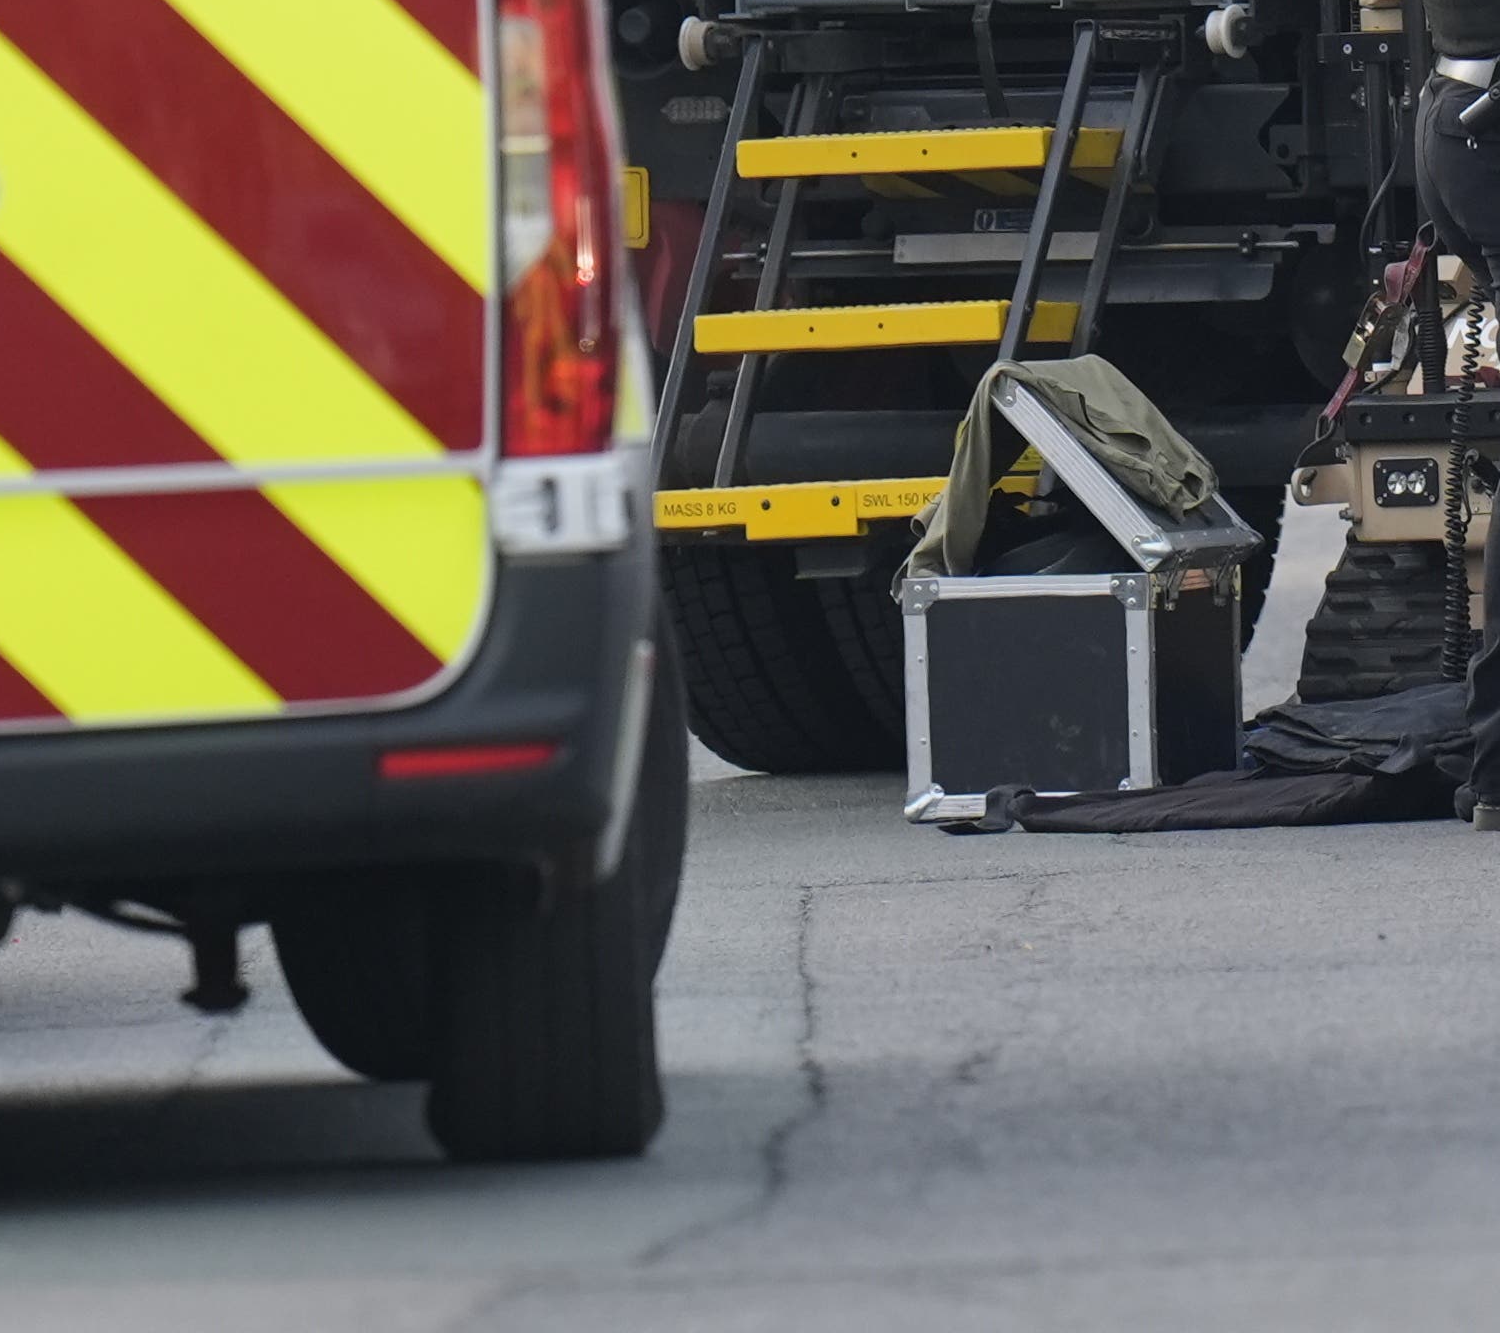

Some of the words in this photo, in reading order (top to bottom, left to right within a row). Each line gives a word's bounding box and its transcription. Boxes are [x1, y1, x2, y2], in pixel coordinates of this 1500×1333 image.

[862, 493, 893, 508] SWL
[898, 492, 920, 507] 150
[663, 502, 703, 517] MASS
[717, 501, 737, 515] KG
